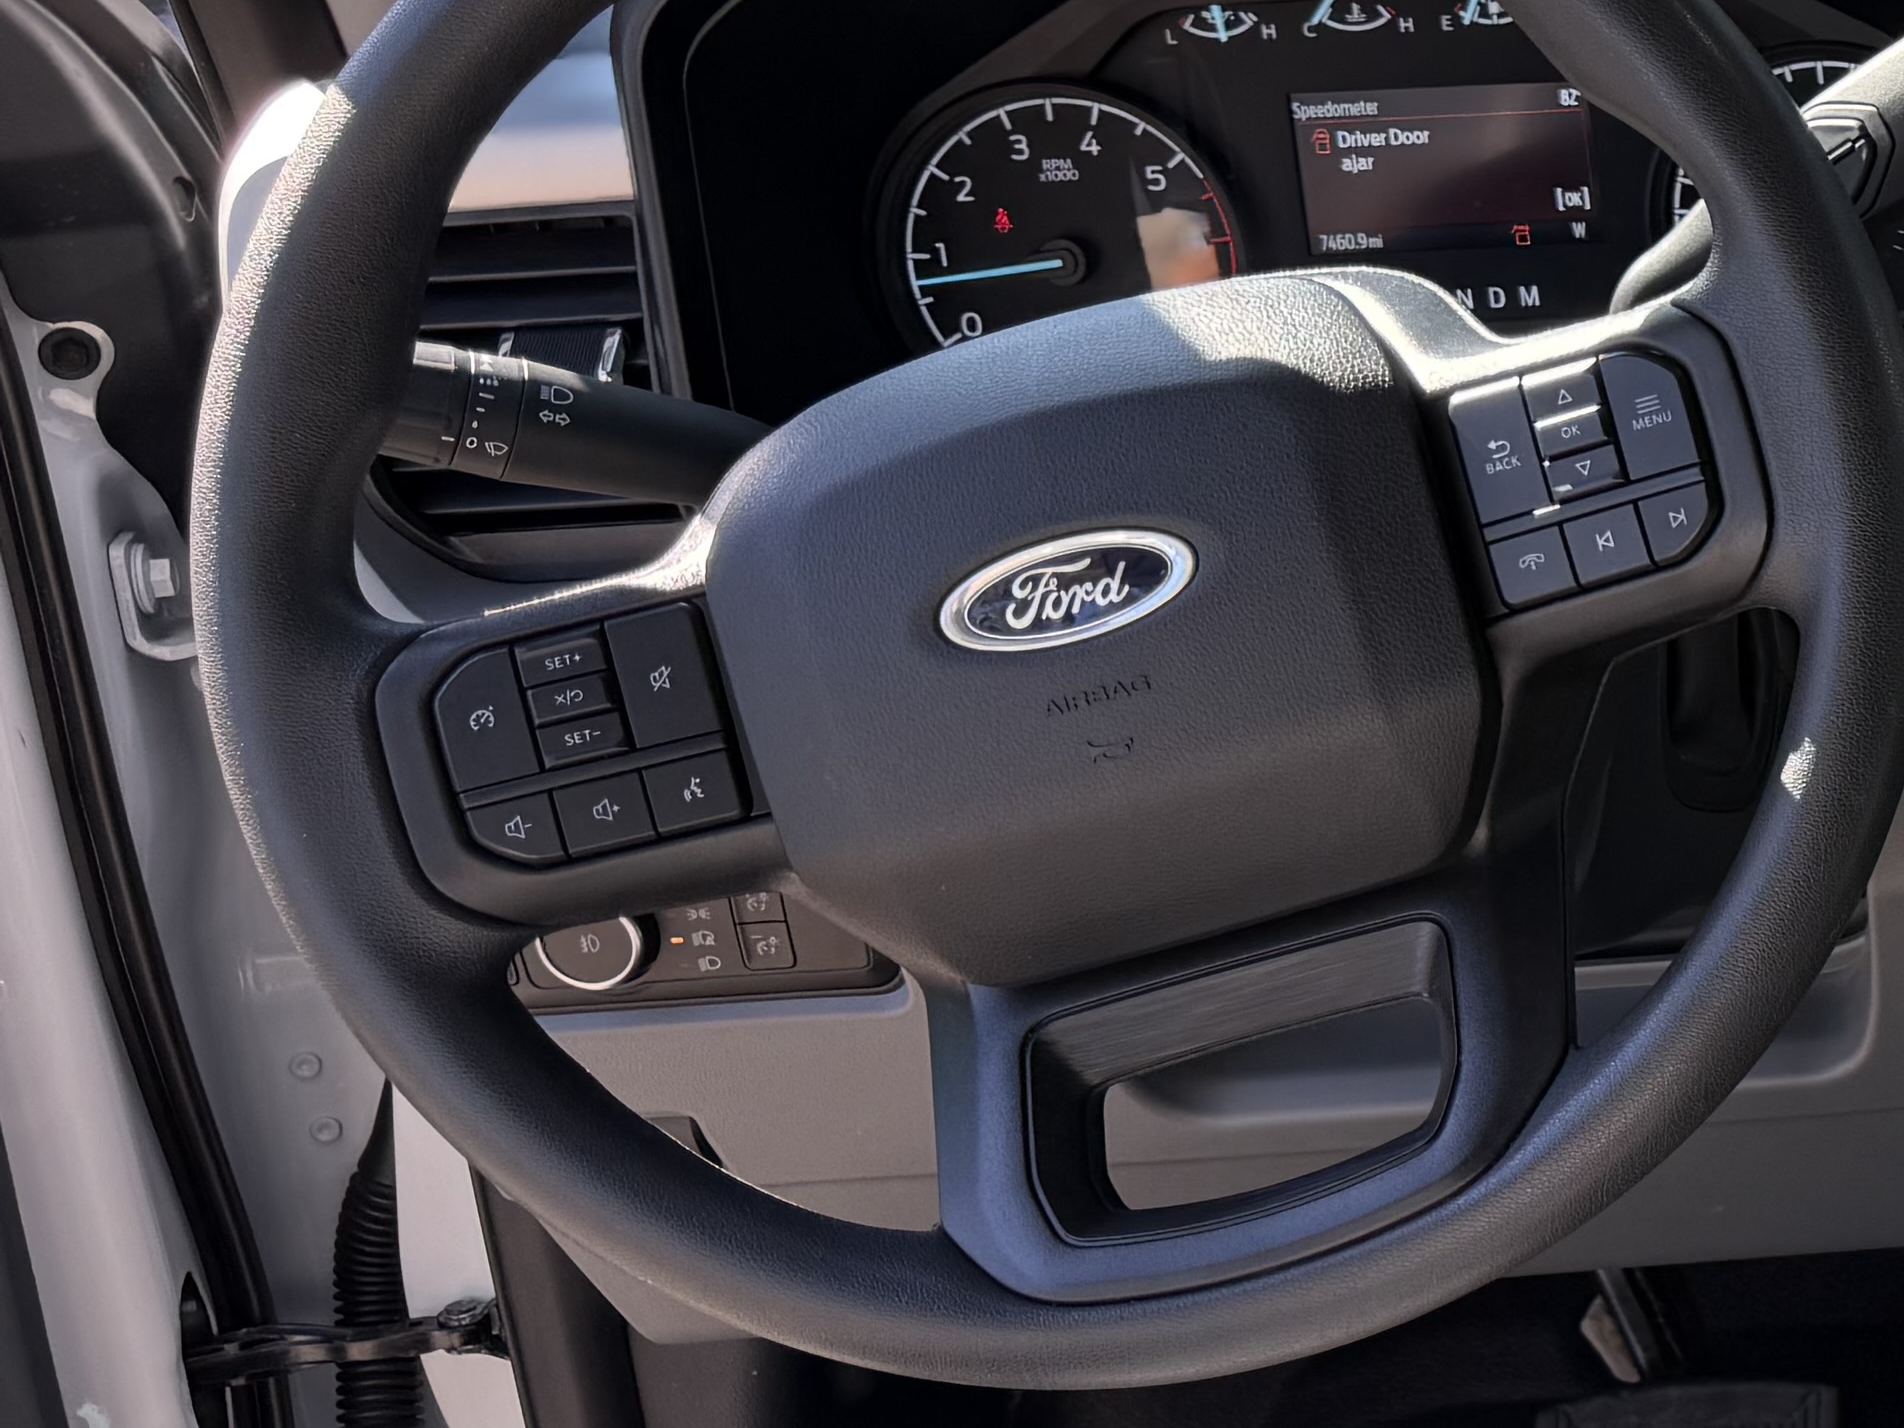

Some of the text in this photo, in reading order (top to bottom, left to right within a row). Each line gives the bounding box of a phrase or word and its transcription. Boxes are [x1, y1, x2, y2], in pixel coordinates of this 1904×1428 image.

[1261, 24, 1278, 40] H
[1303, 23, 1318, 38] C
[1400, 18, 1415, 33] H
[1440, 15, 1455, 31] E
[1165, 29, 1179, 45] L
[1291, 99, 1379, 120] Speedometer
[1009, 134, 1030, 160] 3
[1080, 131, 1102, 156] 4
[1337, 127, 1430, 149] Driver Door
[1042, 159, 1073, 172] RPM
[1340, 154, 1375, 174] ajar
[1039, 170, 1080, 183] x1000
[1144, 165, 1167, 191] 5
[953, 176, 976, 202] 2
[1571, 221, 1587, 240] W
[934, 242, 948, 267] 1
[1487, 286, 1506, 309] D
[1518, 285, 1541, 307] M
[960, 311, 983, 338] 0
[1631, 410, 1673, 432] MENU
[1560, 424, 1581, 439] OK
[1485, 455, 1523, 475] BACK
[1005, 557, 1130, 629] Ford
